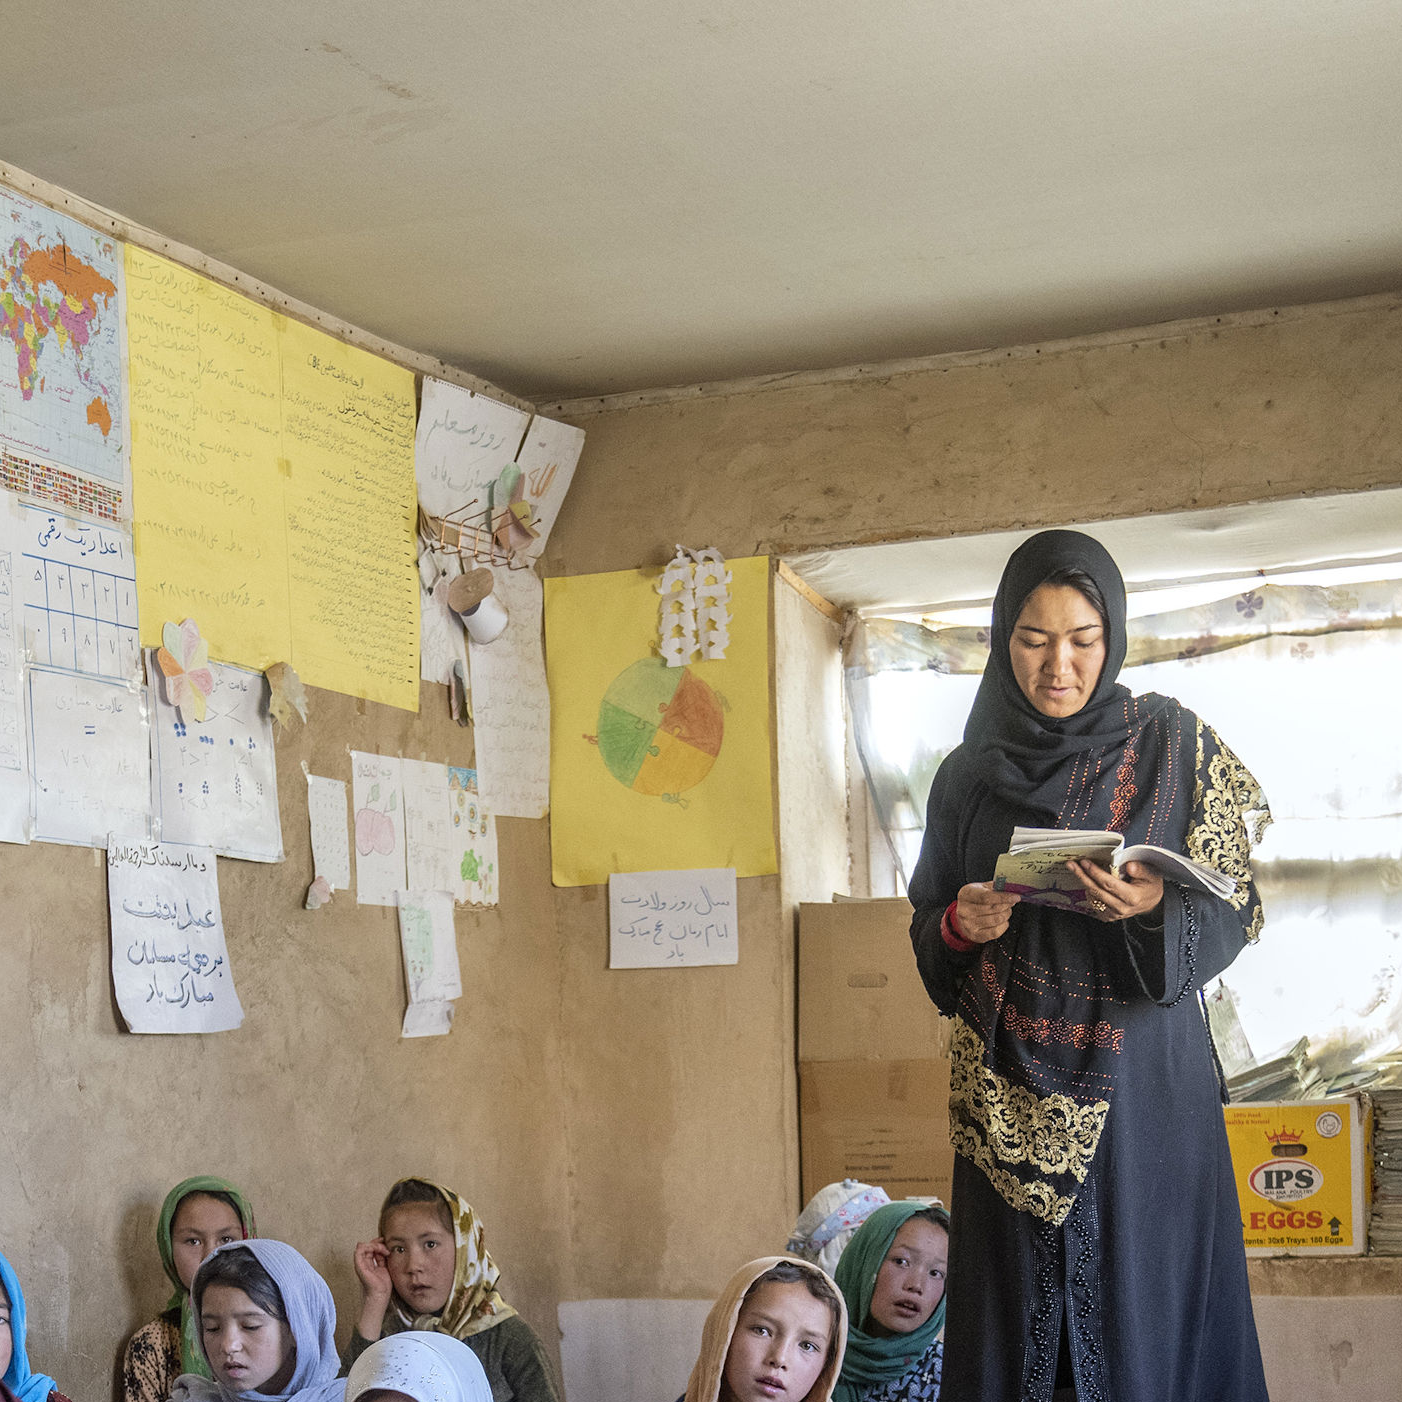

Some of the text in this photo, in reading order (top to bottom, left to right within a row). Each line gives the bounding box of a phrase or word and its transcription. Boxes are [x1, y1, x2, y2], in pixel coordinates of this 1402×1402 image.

[424, 408, 506, 455] روز معلم
[38, 518, 62, 548] رقمی
[64, 527, 91, 557] یک
[87, 531, 124, 560] اعداد
[34, 570, 43, 581] ۵
[620, 890, 667, 911] ولادت
[668, 895, 693, 912] روز
[178, 899, 216, 930] عید
[669, 923, 702, 940] زمان
[704, 923, 728, 948] امام
[666, 944, 685, 962] باد
[146, 970, 214, 1009] مبارک باد
[1263, 1169, 1315, 1190] IPS
[1249, 1211, 1324, 1231] EGGS
[1324, 1236, 1344, 1245] Eggs
